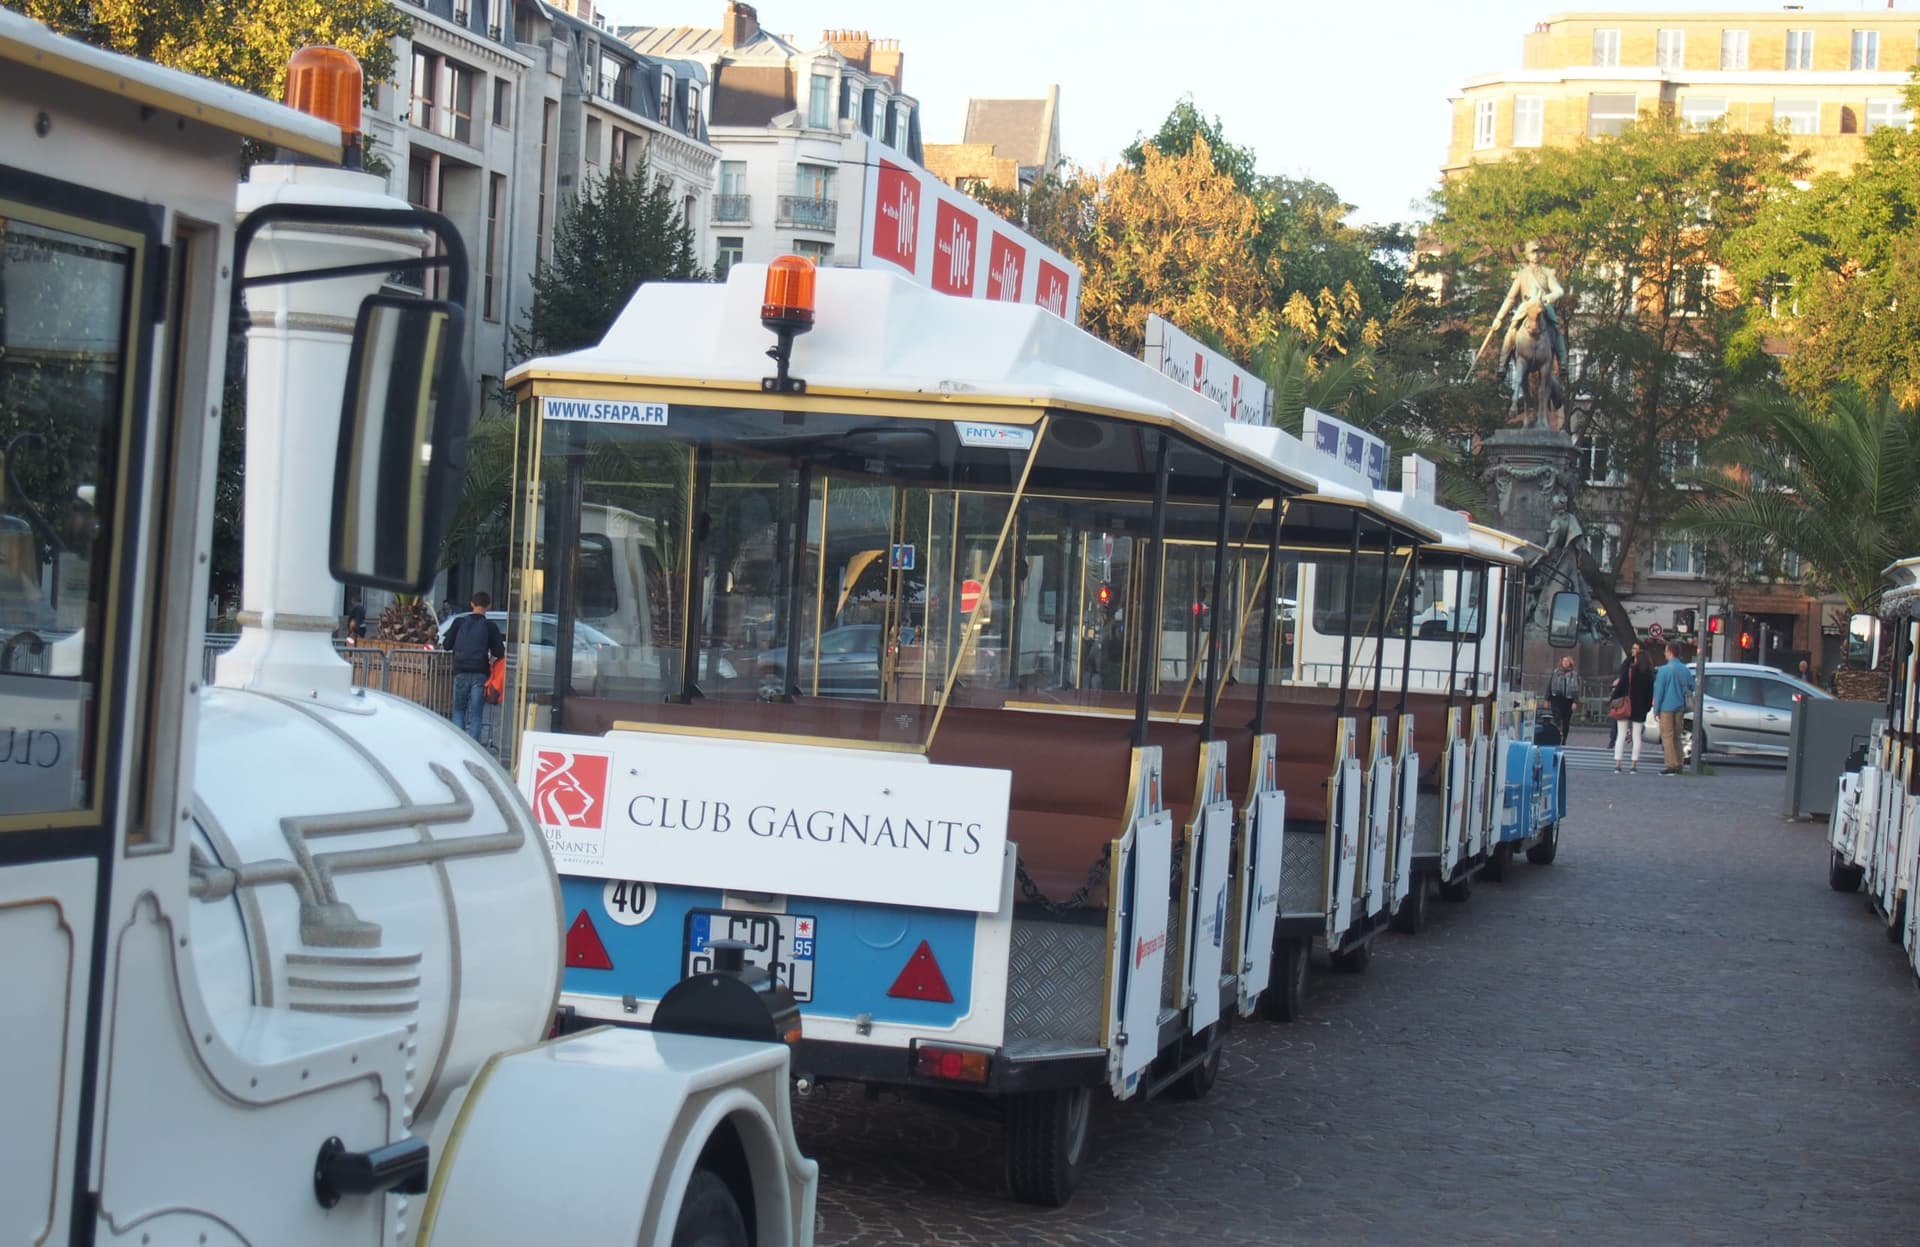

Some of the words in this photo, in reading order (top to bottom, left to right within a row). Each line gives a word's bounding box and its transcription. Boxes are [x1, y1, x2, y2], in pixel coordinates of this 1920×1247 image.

[548, 401, 663, 422] WWW.SFAPA.FR
[966, 427, 998, 438] FNTV
[628, 795, 731, 833] CLUB
[747, 805, 981, 855] GAGNANTS
[545, 829, 562, 840] UB
[612, 880, 646, 914] 40
[696, 936, 704, 947] F
[795, 940, 812, 956] 95
